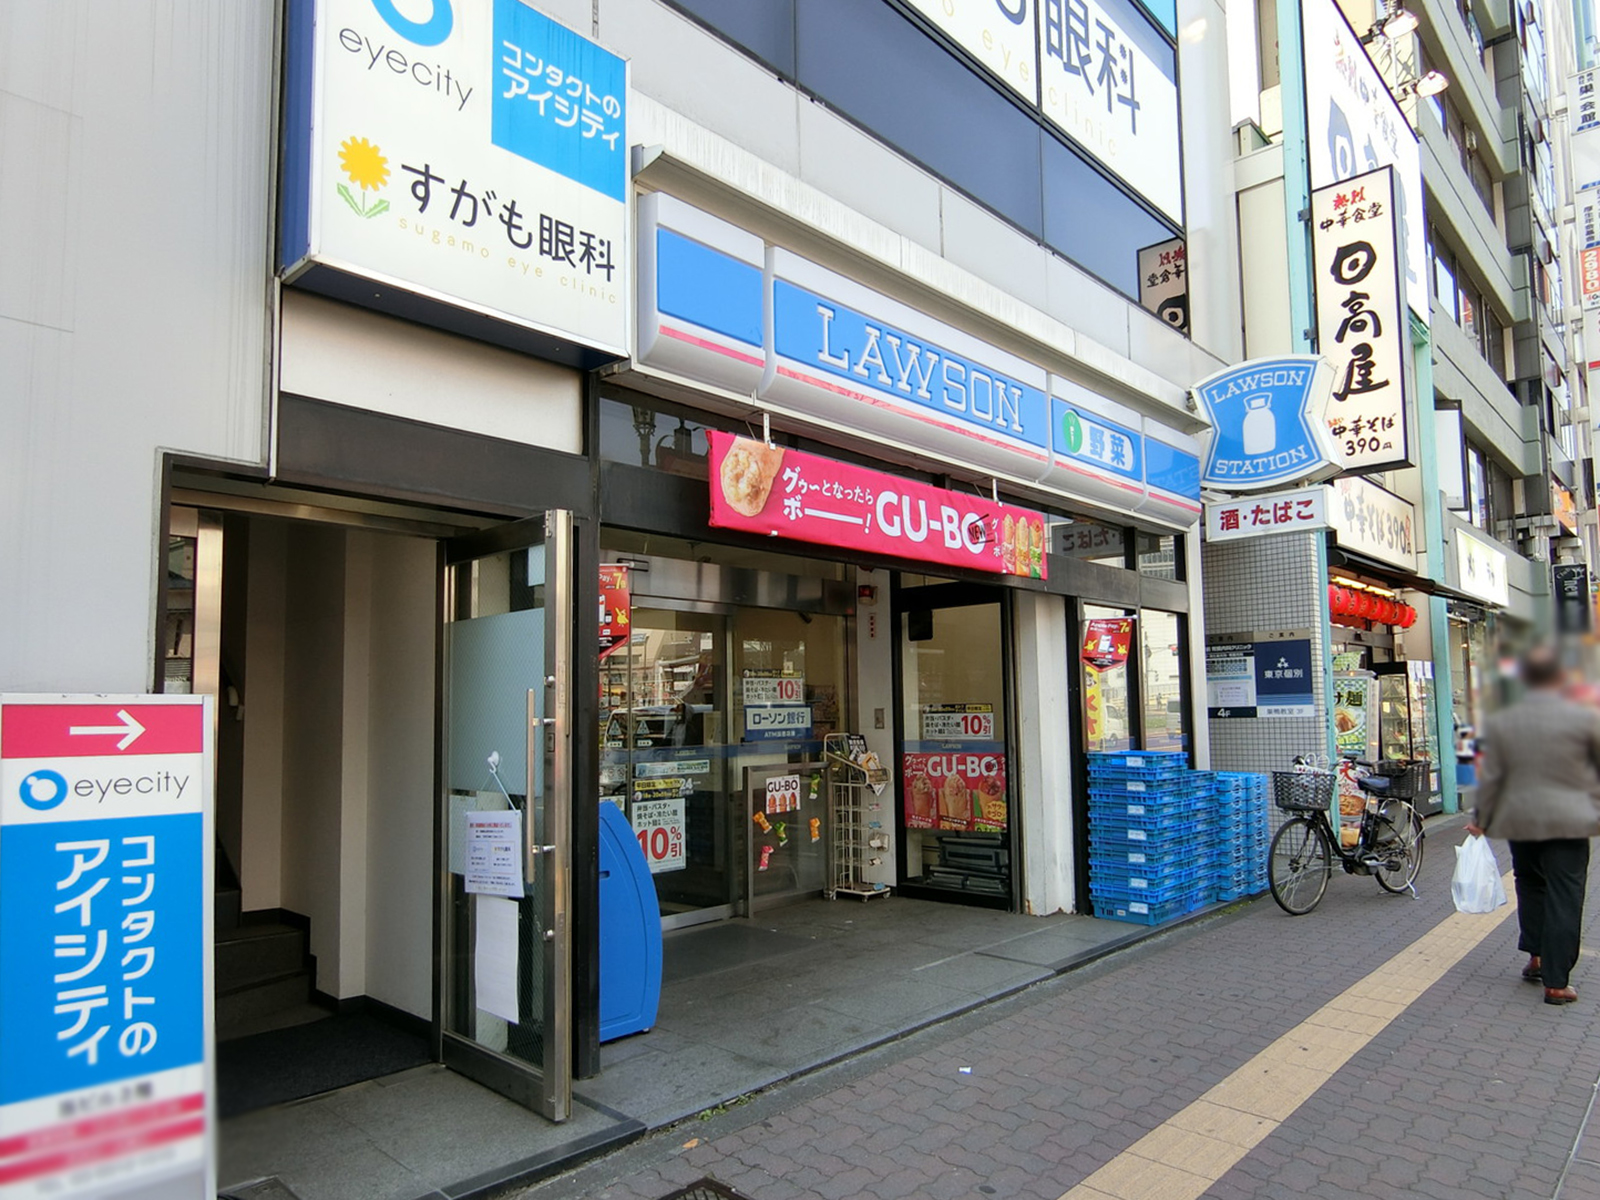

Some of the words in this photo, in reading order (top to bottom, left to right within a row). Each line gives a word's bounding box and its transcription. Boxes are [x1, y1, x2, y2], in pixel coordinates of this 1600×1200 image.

[339, 28, 473, 111] eyecity
[502, 40, 621, 119] コンタクトの
[502, 67, 620, 151] アイシティ
[982, 28, 1029, 82] eye
[1048, 86, 1117, 157] clinic
[401, 163, 615, 283] すがも眼科
[1320, 202, 1383, 232] 中華食堂
[399, 216, 490, 260] sugamo
[507, 256, 543, 278] eye
[559, 274, 617, 304] clinic
[1331, 240, 1390, 402] 日高屋
[816, 304, 1024, 434] LAWSON
[1211, 370, 1305, 404] LAWSON
[1089, 424, 1127, 467] 野菜
[1332, 413, 1397, 439] 中華そば
[1345, 436, 1392, 456] 390円
[1214, 445, 1309, 475] STATION
[1264, 669, 1304, 679] 東京個別
[753, 711, 805, 725] ローソン銀行
[1217, 708, 1232, 717] 4F
[74, 771, 190, 804] eyecity
[767, 779, 799, 793] GU-BO
[54, 839, 112, 1067] アイシティ
[119, 835, 158, 1058] コンタクトの
